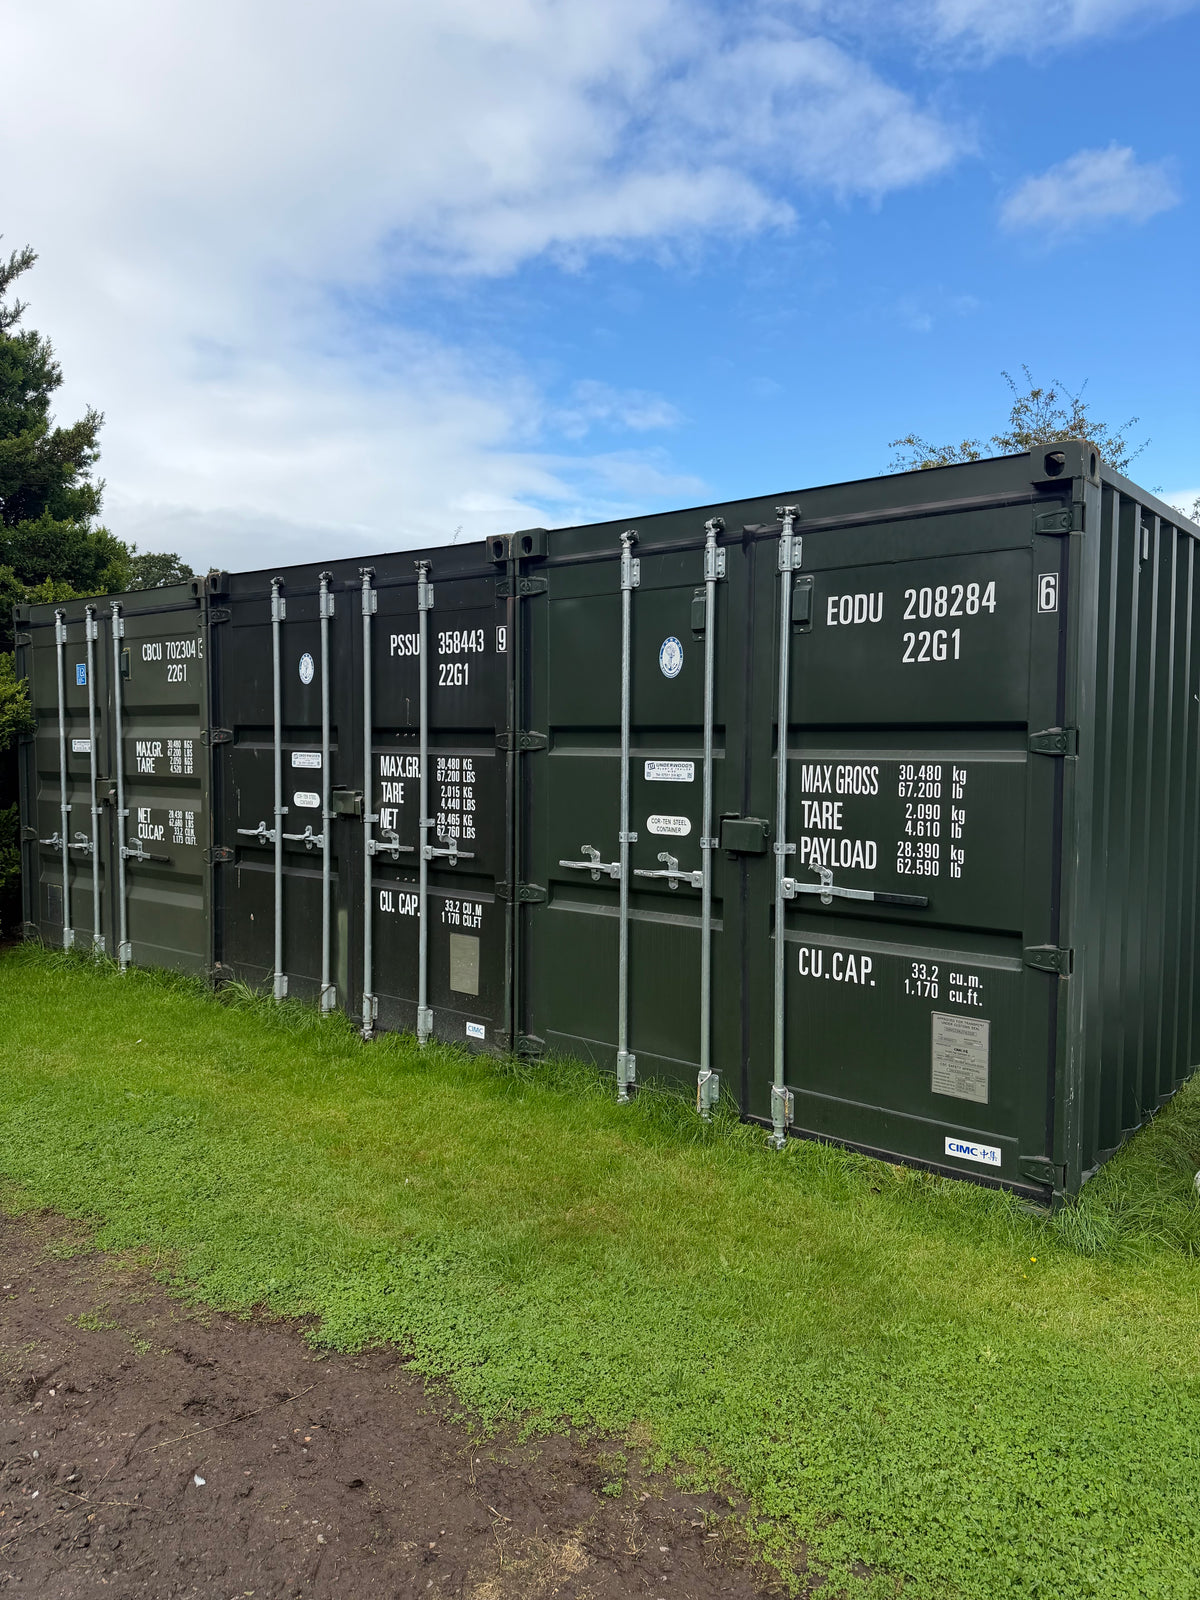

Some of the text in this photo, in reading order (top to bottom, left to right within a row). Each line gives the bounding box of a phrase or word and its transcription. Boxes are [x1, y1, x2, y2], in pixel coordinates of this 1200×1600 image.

[827, 576, 1056, 626] EODU 208284 6
[142, 643, 162, 661] CBCU
[165, 640, 196, 659] 702304
[390, 627, 506, 656] PSSU 358443 9
[902, 628, 960, 663] 22G1
[167, 664, 187, 682] 22G1
[439, 662, 469, 686] 22G1
[184, 749, 193, 757] LBS
[136, 757, 155, 773] TARE
[184, 765, 193, 774] LBS
[380, 755, 472, 778] MAX.GR. 30,480 KG
[437, 770, 475, 783] 67,200 LBS
[801, 765, 967, 795] MAX GROSS 30,480 kg
[381, 782, 472, 803] TARE 2,015 KG
[899, 782, 963, 799] 67,200 lb
[441, 798, 476, 811] 4,440 LBS
[138, 807, 151, 823] NET
[185, 820, 194, 828] LBS
[380, 808, 472, 829] NET 28,465 KG
[801, 800, 965, 830] TARE 2,090 kg
[437, 825, 475, 839] 62760 LBS
[905, 820, 962, 838] 4,610 lb
[800, 836, 964, 869] PAYLOAD 28,390 kg
[897, 858, 961, 878] 62,590 lb
[445, 900, 460, 913] 33.2
[463, 914, 482, 928] CU.FT
[799, 947, 983, 989] CU.CAP. 33.2 cu.m.
[904, 979, 983, 1006] 1,170 cu.ft.
[468, 1025, 483, 1035] CIMC
[948, 1143, 978, 1156] CIMC
